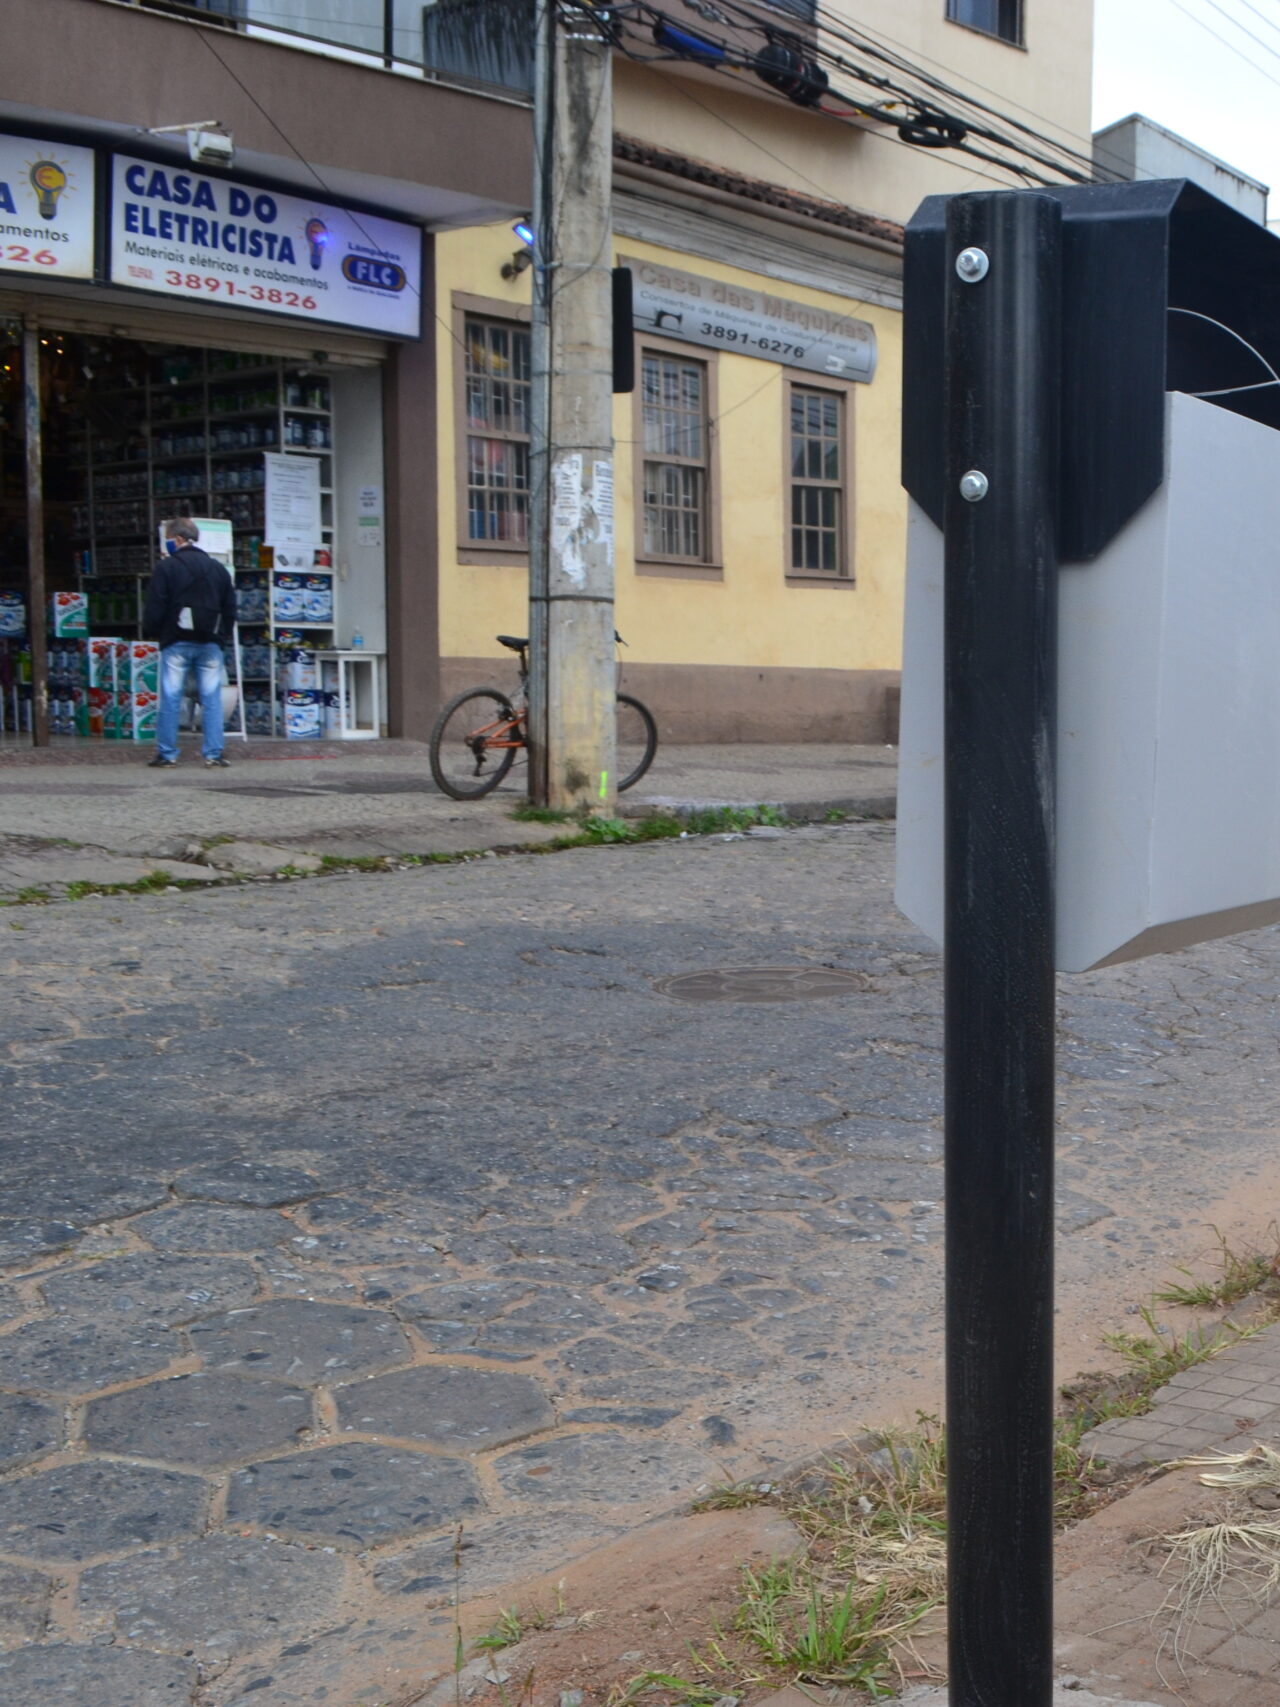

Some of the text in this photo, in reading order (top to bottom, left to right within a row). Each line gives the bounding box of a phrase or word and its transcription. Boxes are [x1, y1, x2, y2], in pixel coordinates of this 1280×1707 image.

[125, 165, 278, 224] CASA DO
[124, 202, 296, 265] ELETRICISTA
[125, 240, 329, 291] Materiais elétricos e acabamentos
[165, 270, 318, 310] 3891-3826
[356, 261, 393, 287] FLC
[639, 264, 868, 342] Casa das Máquinas
[700, 322, 805, 359] 3891-6276
